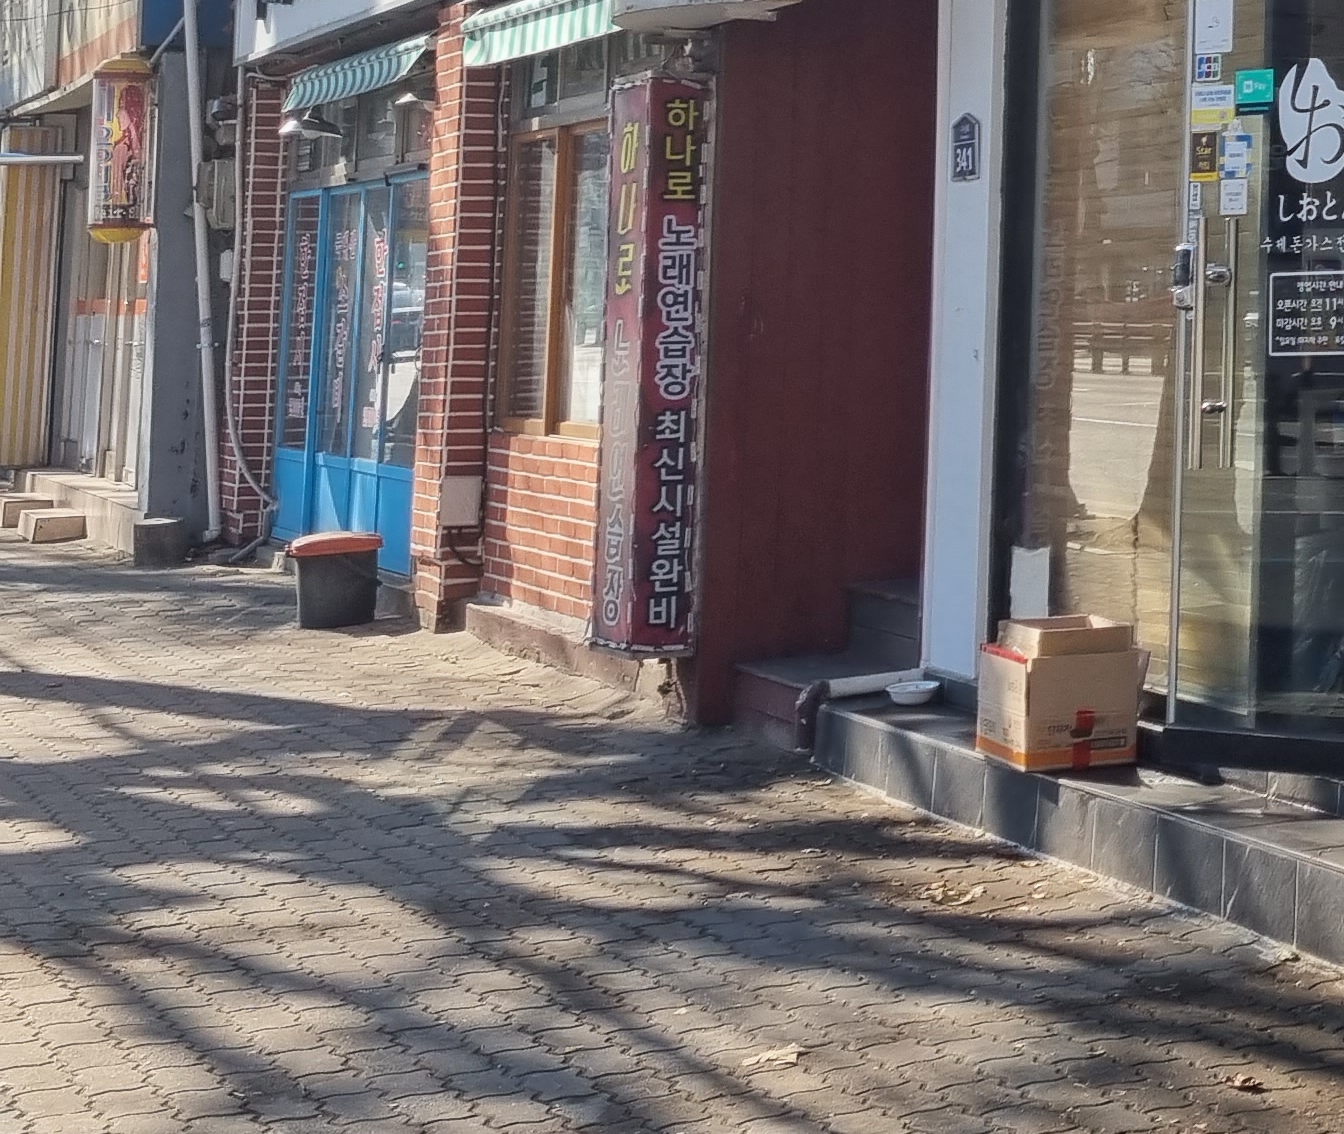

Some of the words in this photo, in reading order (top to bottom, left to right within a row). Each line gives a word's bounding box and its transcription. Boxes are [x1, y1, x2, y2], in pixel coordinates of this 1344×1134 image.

[663, 98, 699, 201] 하나로
[956, 147, 972, 172] 341
[615, 121, 639, 296] 하나로
[655, 215, 698, 401] 노래연습장
[1276, 299, 1307, 312] 오픈시간
[1276, 318, 1307, 330] 마감시간
[648, 410, 687, 629] 최신시설완비
